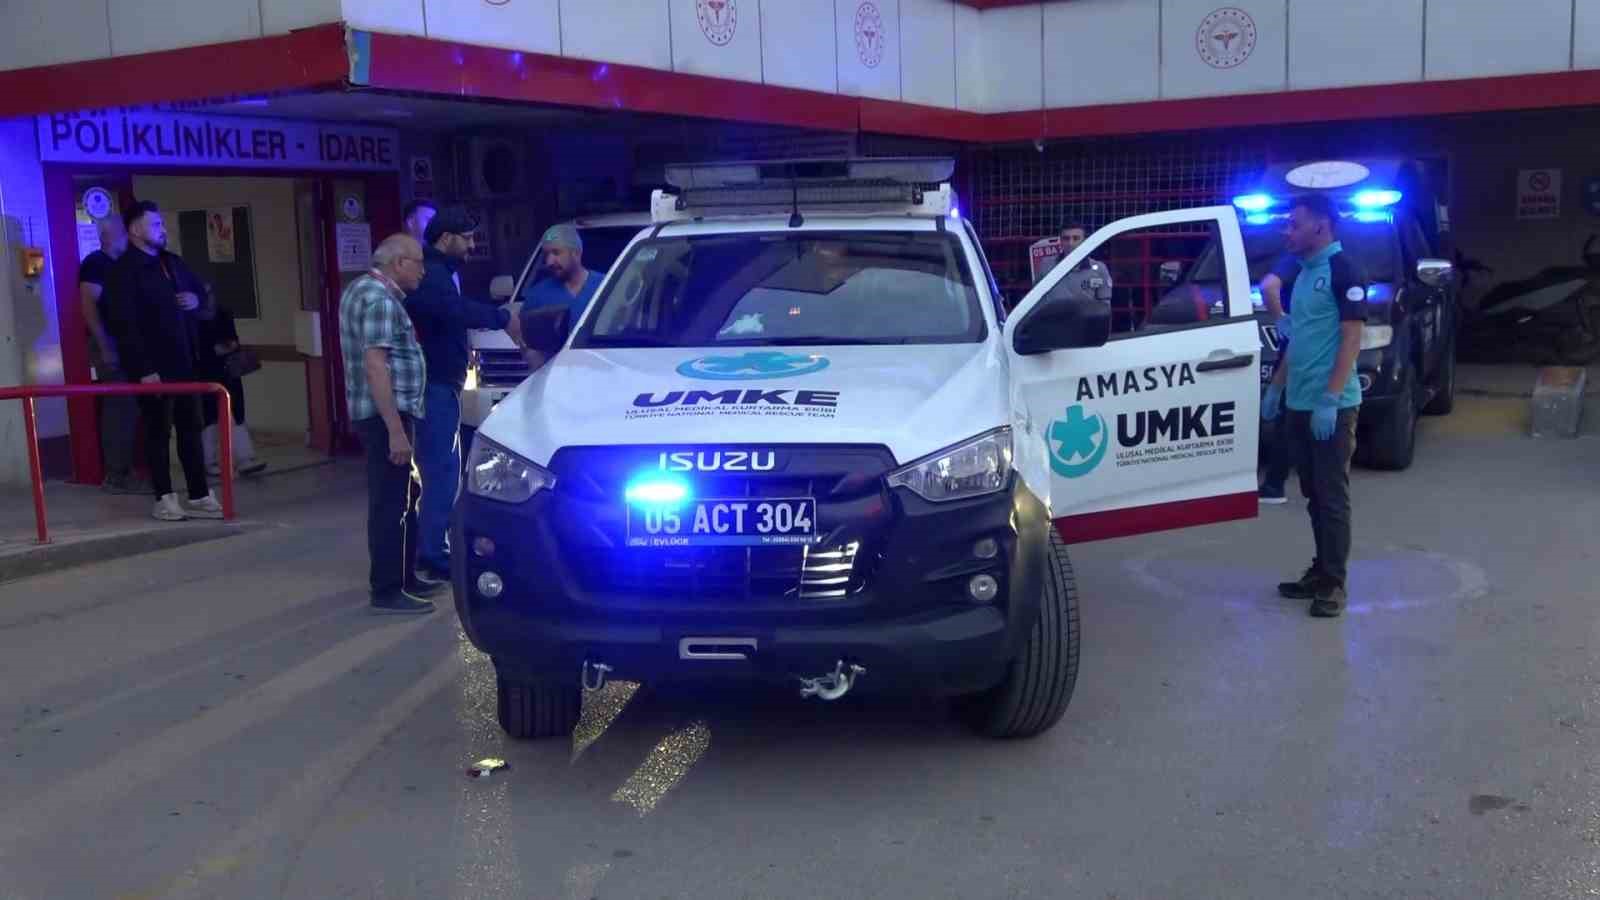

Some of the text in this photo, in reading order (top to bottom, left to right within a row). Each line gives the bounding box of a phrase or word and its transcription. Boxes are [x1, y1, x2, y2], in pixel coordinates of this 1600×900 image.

[51, 116, 288, 161] POLİKLİNİKLER
[318, 127, 393, 165] İDARE
[633, 389, 840, 407] UMKE
[1076, 361, 1196, 402] AMASYA
[1116, 401, 1236, 448] UMKE
[658, 451, 776, 472] ISUZU
[644, 502, 812, 534] 05 ACT 304
